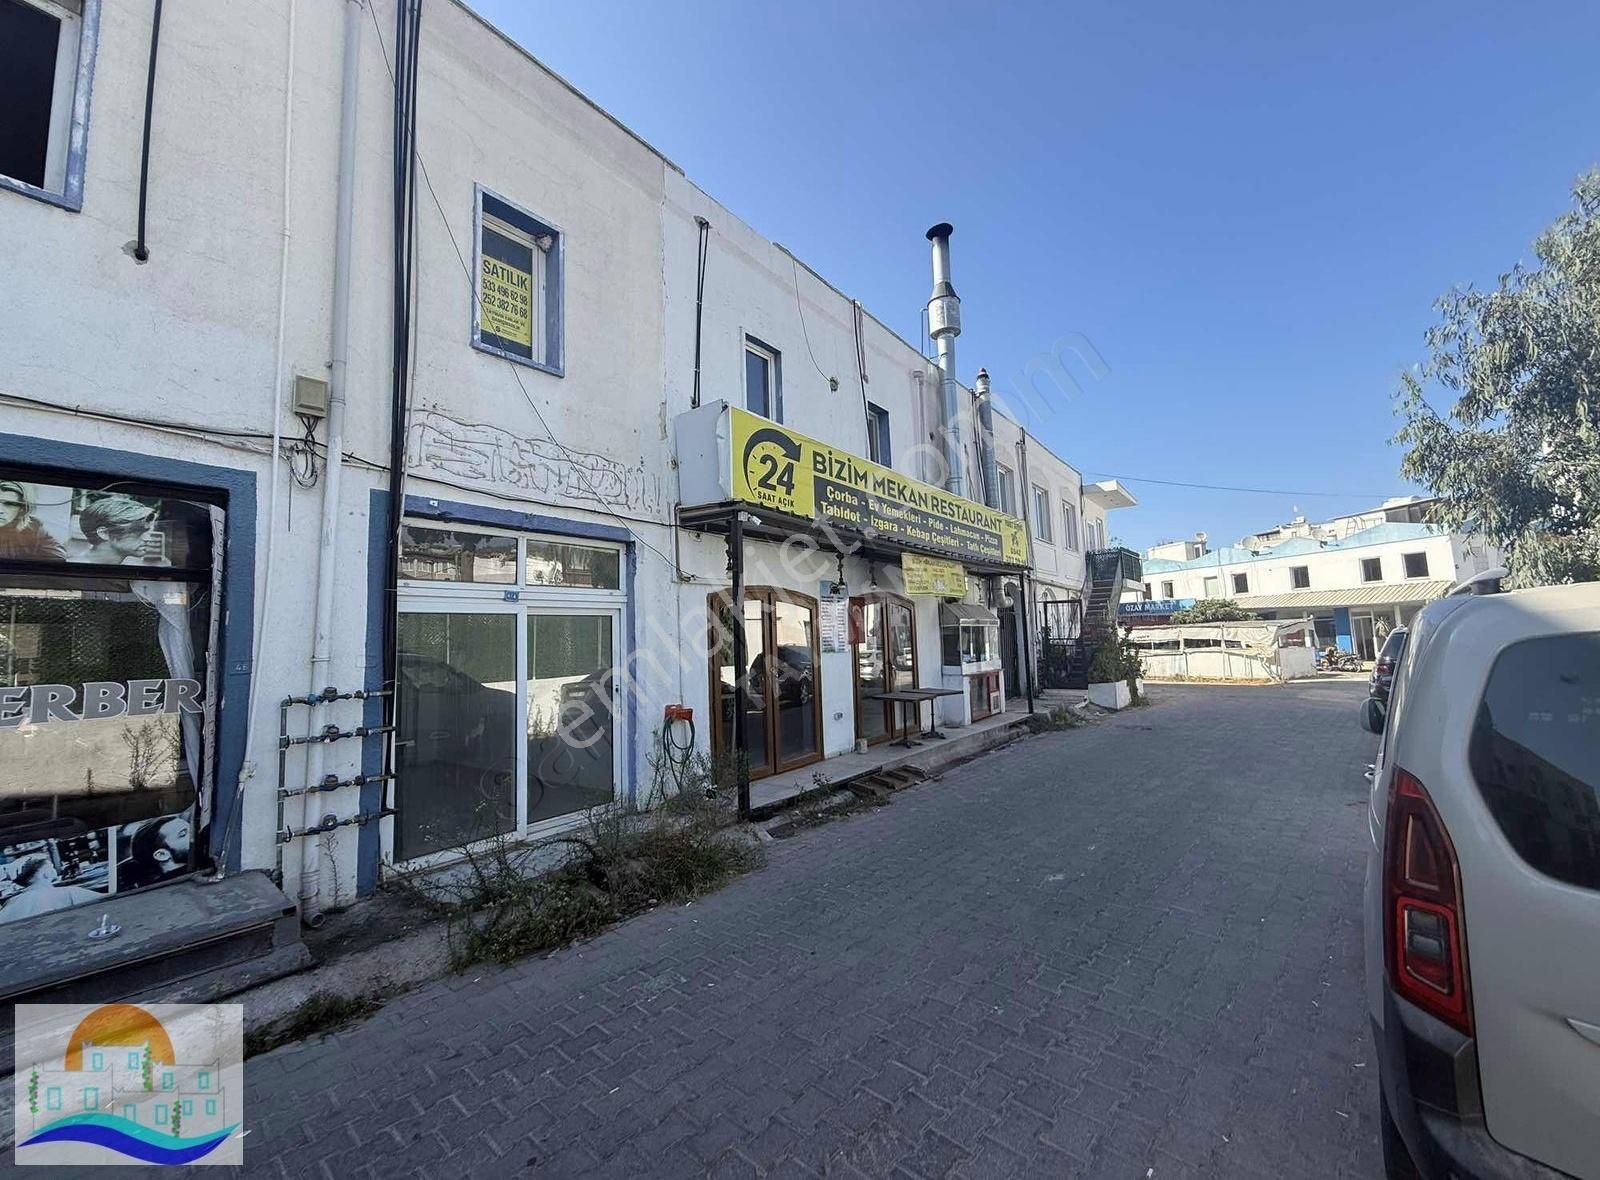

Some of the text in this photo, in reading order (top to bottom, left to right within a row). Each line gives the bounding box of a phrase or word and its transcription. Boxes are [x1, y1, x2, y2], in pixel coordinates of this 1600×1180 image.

[483, 260, 527, 291] SATILIK
[482, 293, 496, 307] 252
[758, 454, 795, 496] 24
[812, 450, 1002, 532] BİZİM MEKAN RESTAURANT
[757, 491, 795, 508] SAAT AÇIK
[826, 485, 858, 506] Çorba
[868, 498, 880, 512] Ev
[881, 502, 921, 524] Yemekleri
[928, 517, 944, 531] Pide
[820, 501, 860, 523] Tabldot
[906, 525, 930, 542] Kebap
